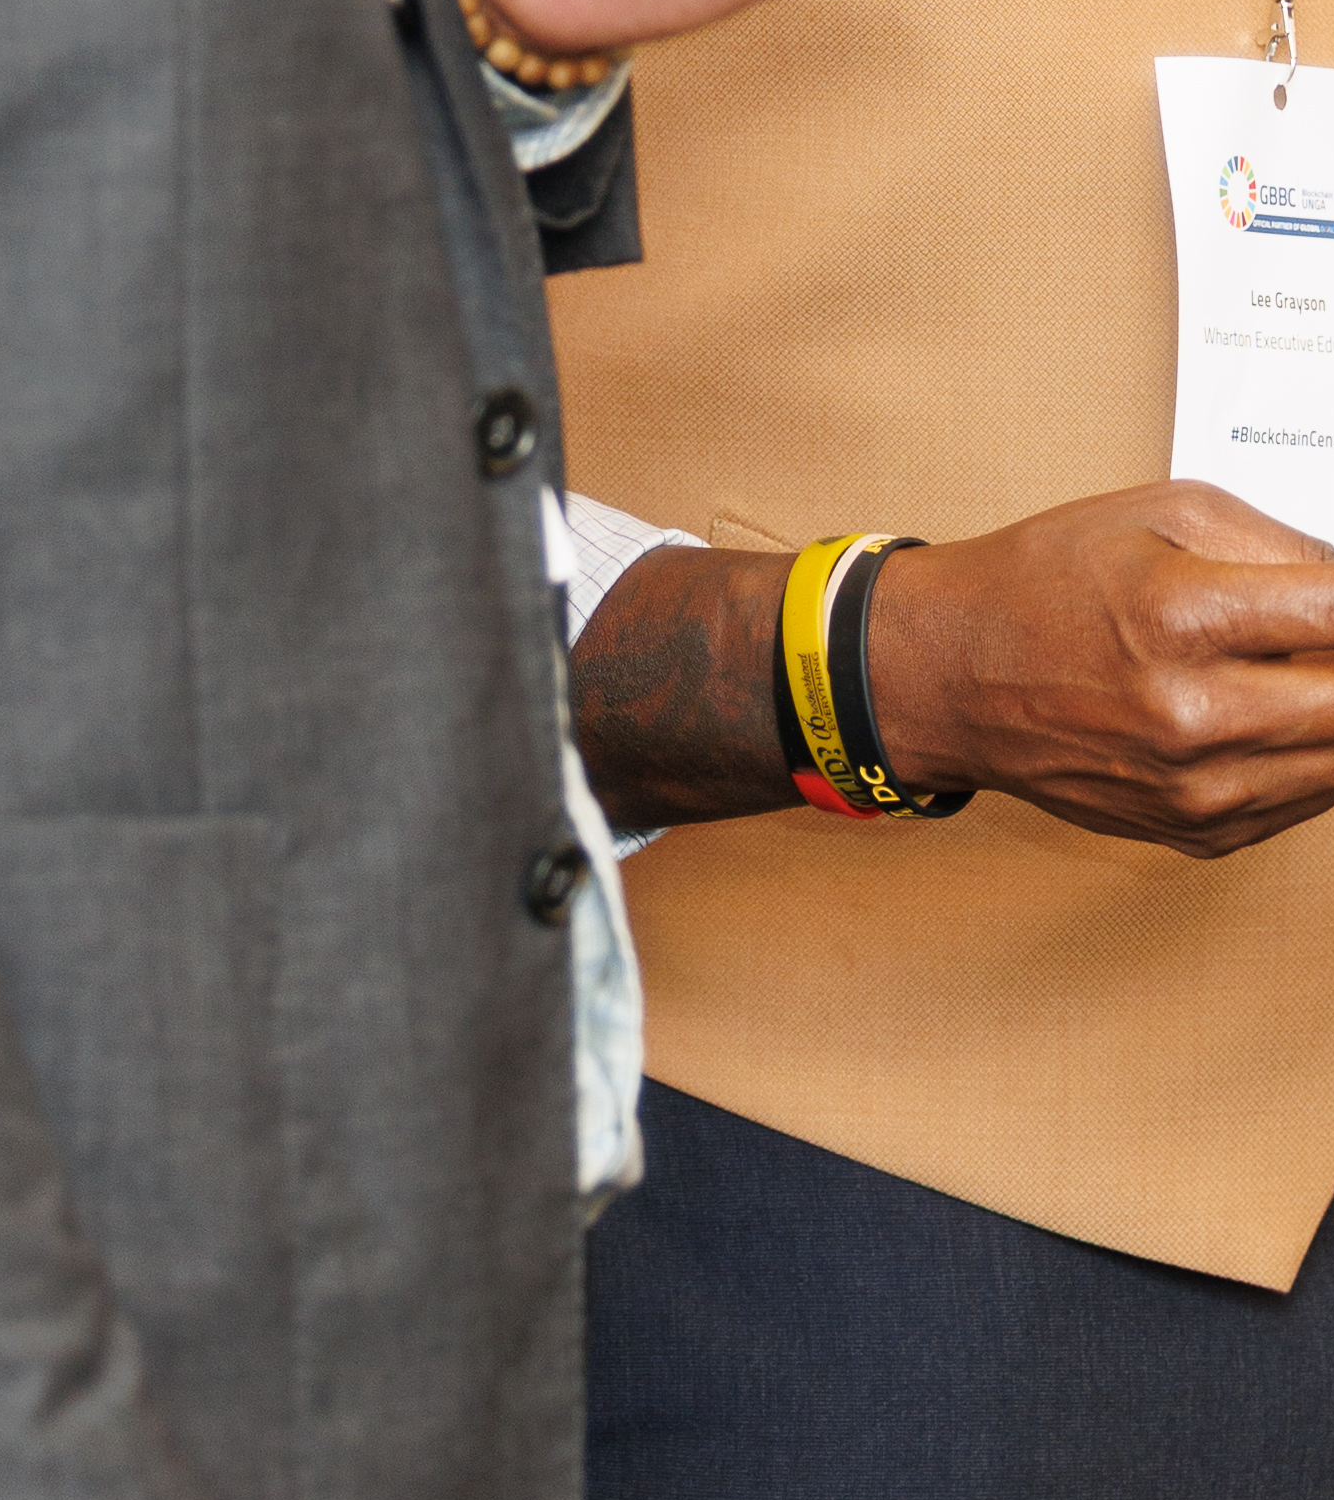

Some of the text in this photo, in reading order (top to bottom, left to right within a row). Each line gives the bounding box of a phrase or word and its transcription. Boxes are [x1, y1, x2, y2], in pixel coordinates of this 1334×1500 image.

[1260, 185, 1296, 207] GBBC
[1302, 199, 1326, 210] UNGA
[1250, 290, 1326, 315] Lee Grayson
[1203, 326, 1252, 348] Wharton
[1255, 331, 1314, 352] Executive
[814, 651, 836, 731] EVERYTHING
[859, 764, 901, 802] DC
